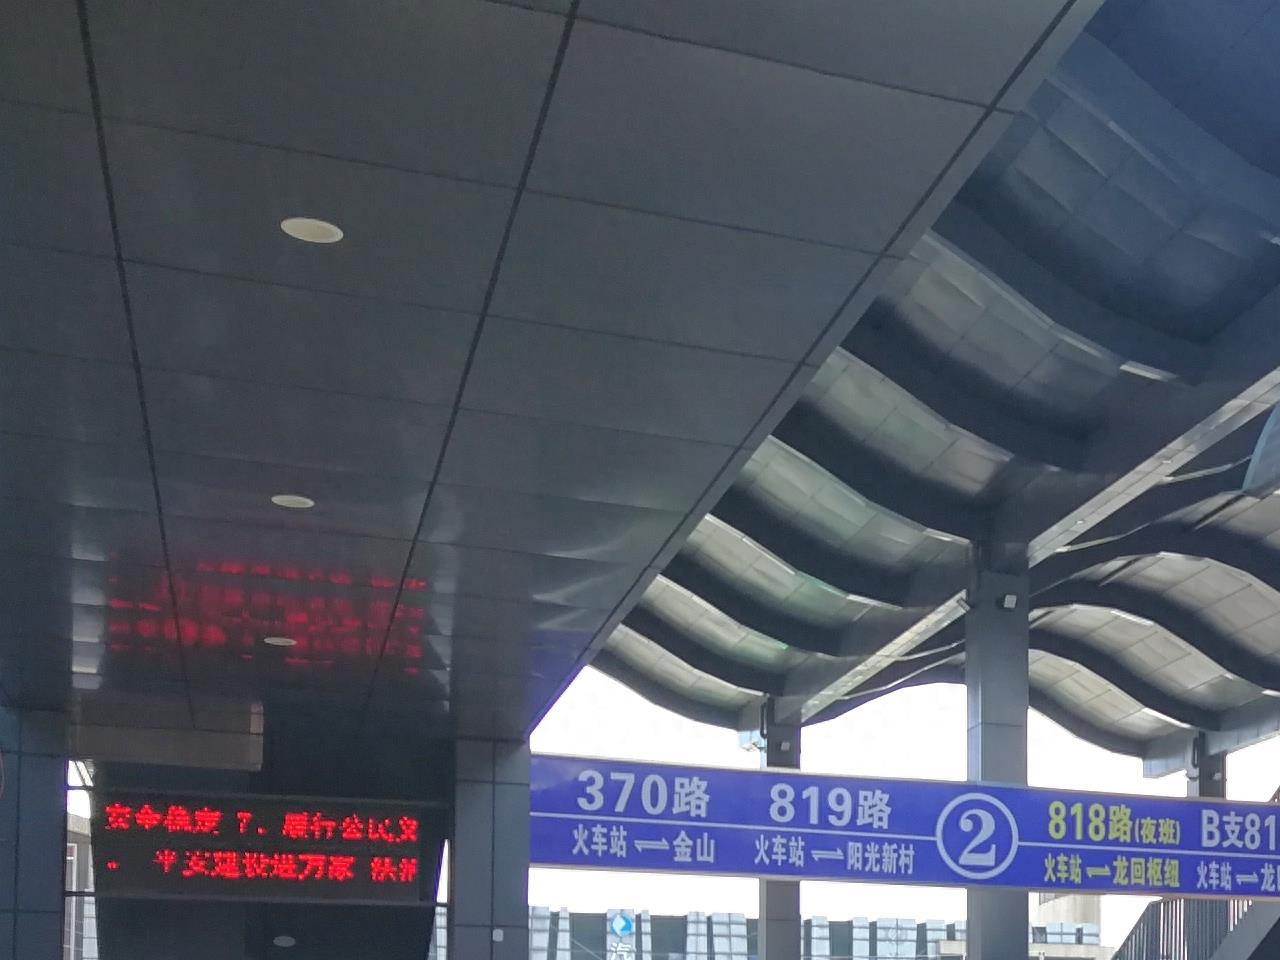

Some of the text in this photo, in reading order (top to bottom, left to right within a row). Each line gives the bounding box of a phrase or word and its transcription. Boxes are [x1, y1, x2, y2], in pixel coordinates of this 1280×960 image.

[576, 769, 710, 818] 370路
[769, 783, 893, 830] 819路
[571, 823, 716, 864] 火车站 金山
[754, 834, 915, 875] 火车站 阳光新村
[1044, 853, 1181, 888] 火车站 龙回枢纽
[1197, 861, 1233, 891] 火车站
